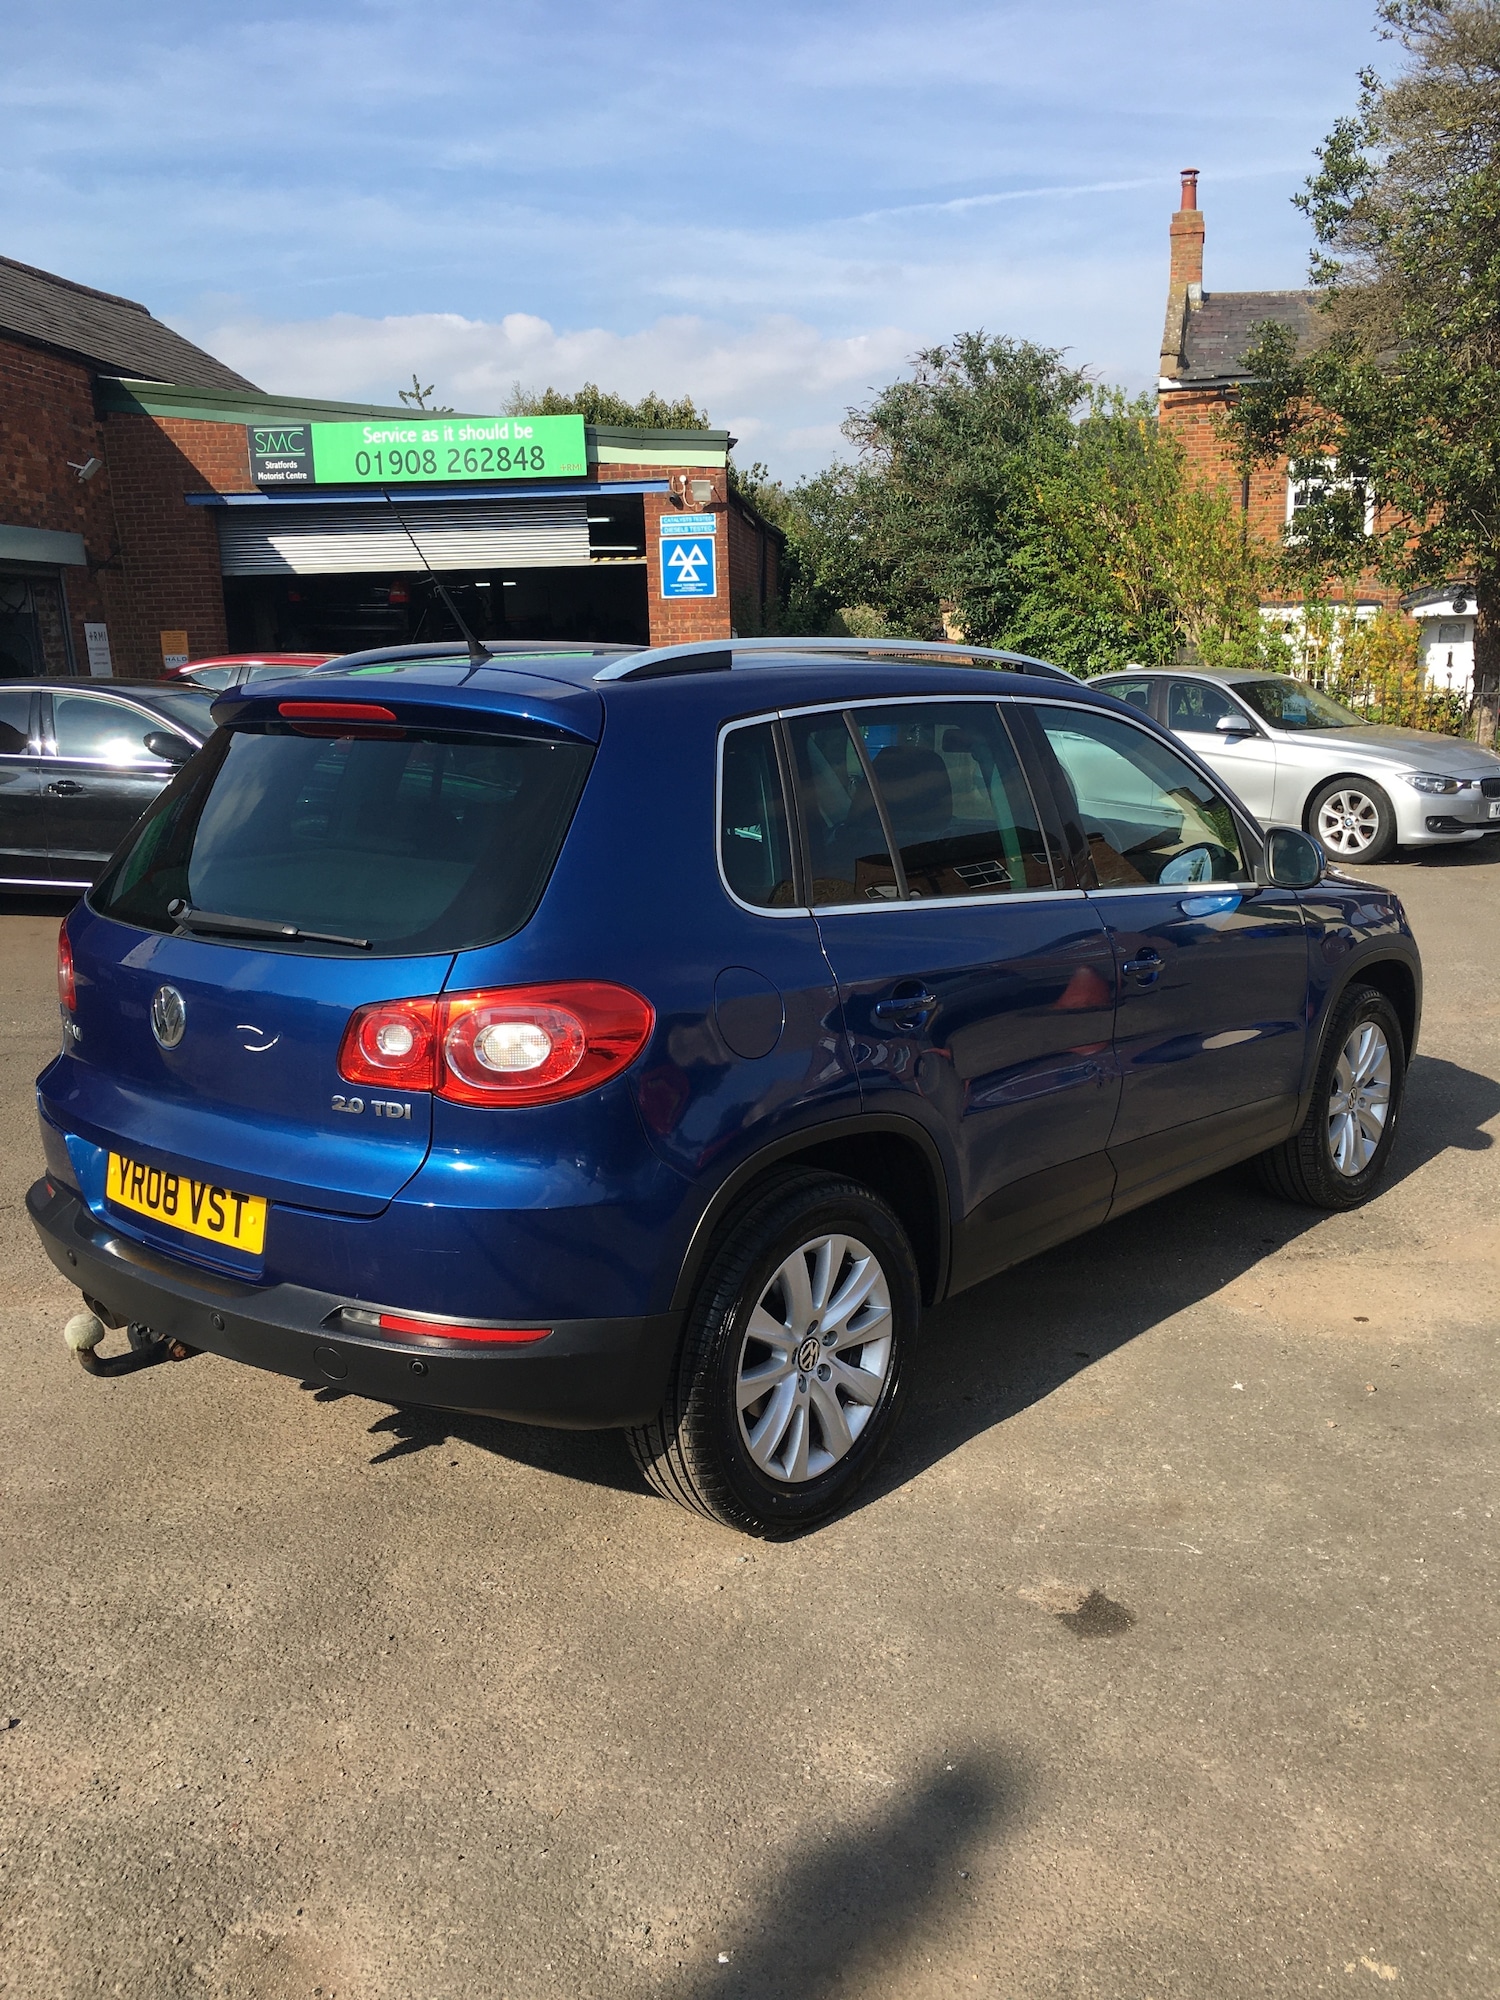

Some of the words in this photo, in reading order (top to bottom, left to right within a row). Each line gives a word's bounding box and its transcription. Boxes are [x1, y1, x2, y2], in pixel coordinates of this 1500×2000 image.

[254, 431, 305, 453] SMC
[363, 426, 417, 444] Service
[421, 429, 439, 442] as
[443, 425, 454, 442] it
[458, 422, 509, 441] should
[513, 422, 533, 439] be
[265, 460, 298, 469] Stratfords
[355, 449, 437, 476] 01908
[447, 445, 545, 473] 262848
[257, 472, 285, 480] Motorist
[285, 471, 307, 479] Centre
[370, 1100, 412, 1120] TDI
[119, 1155, 179, 1216] YR08
[189, 1178, 250, 1239] VST
